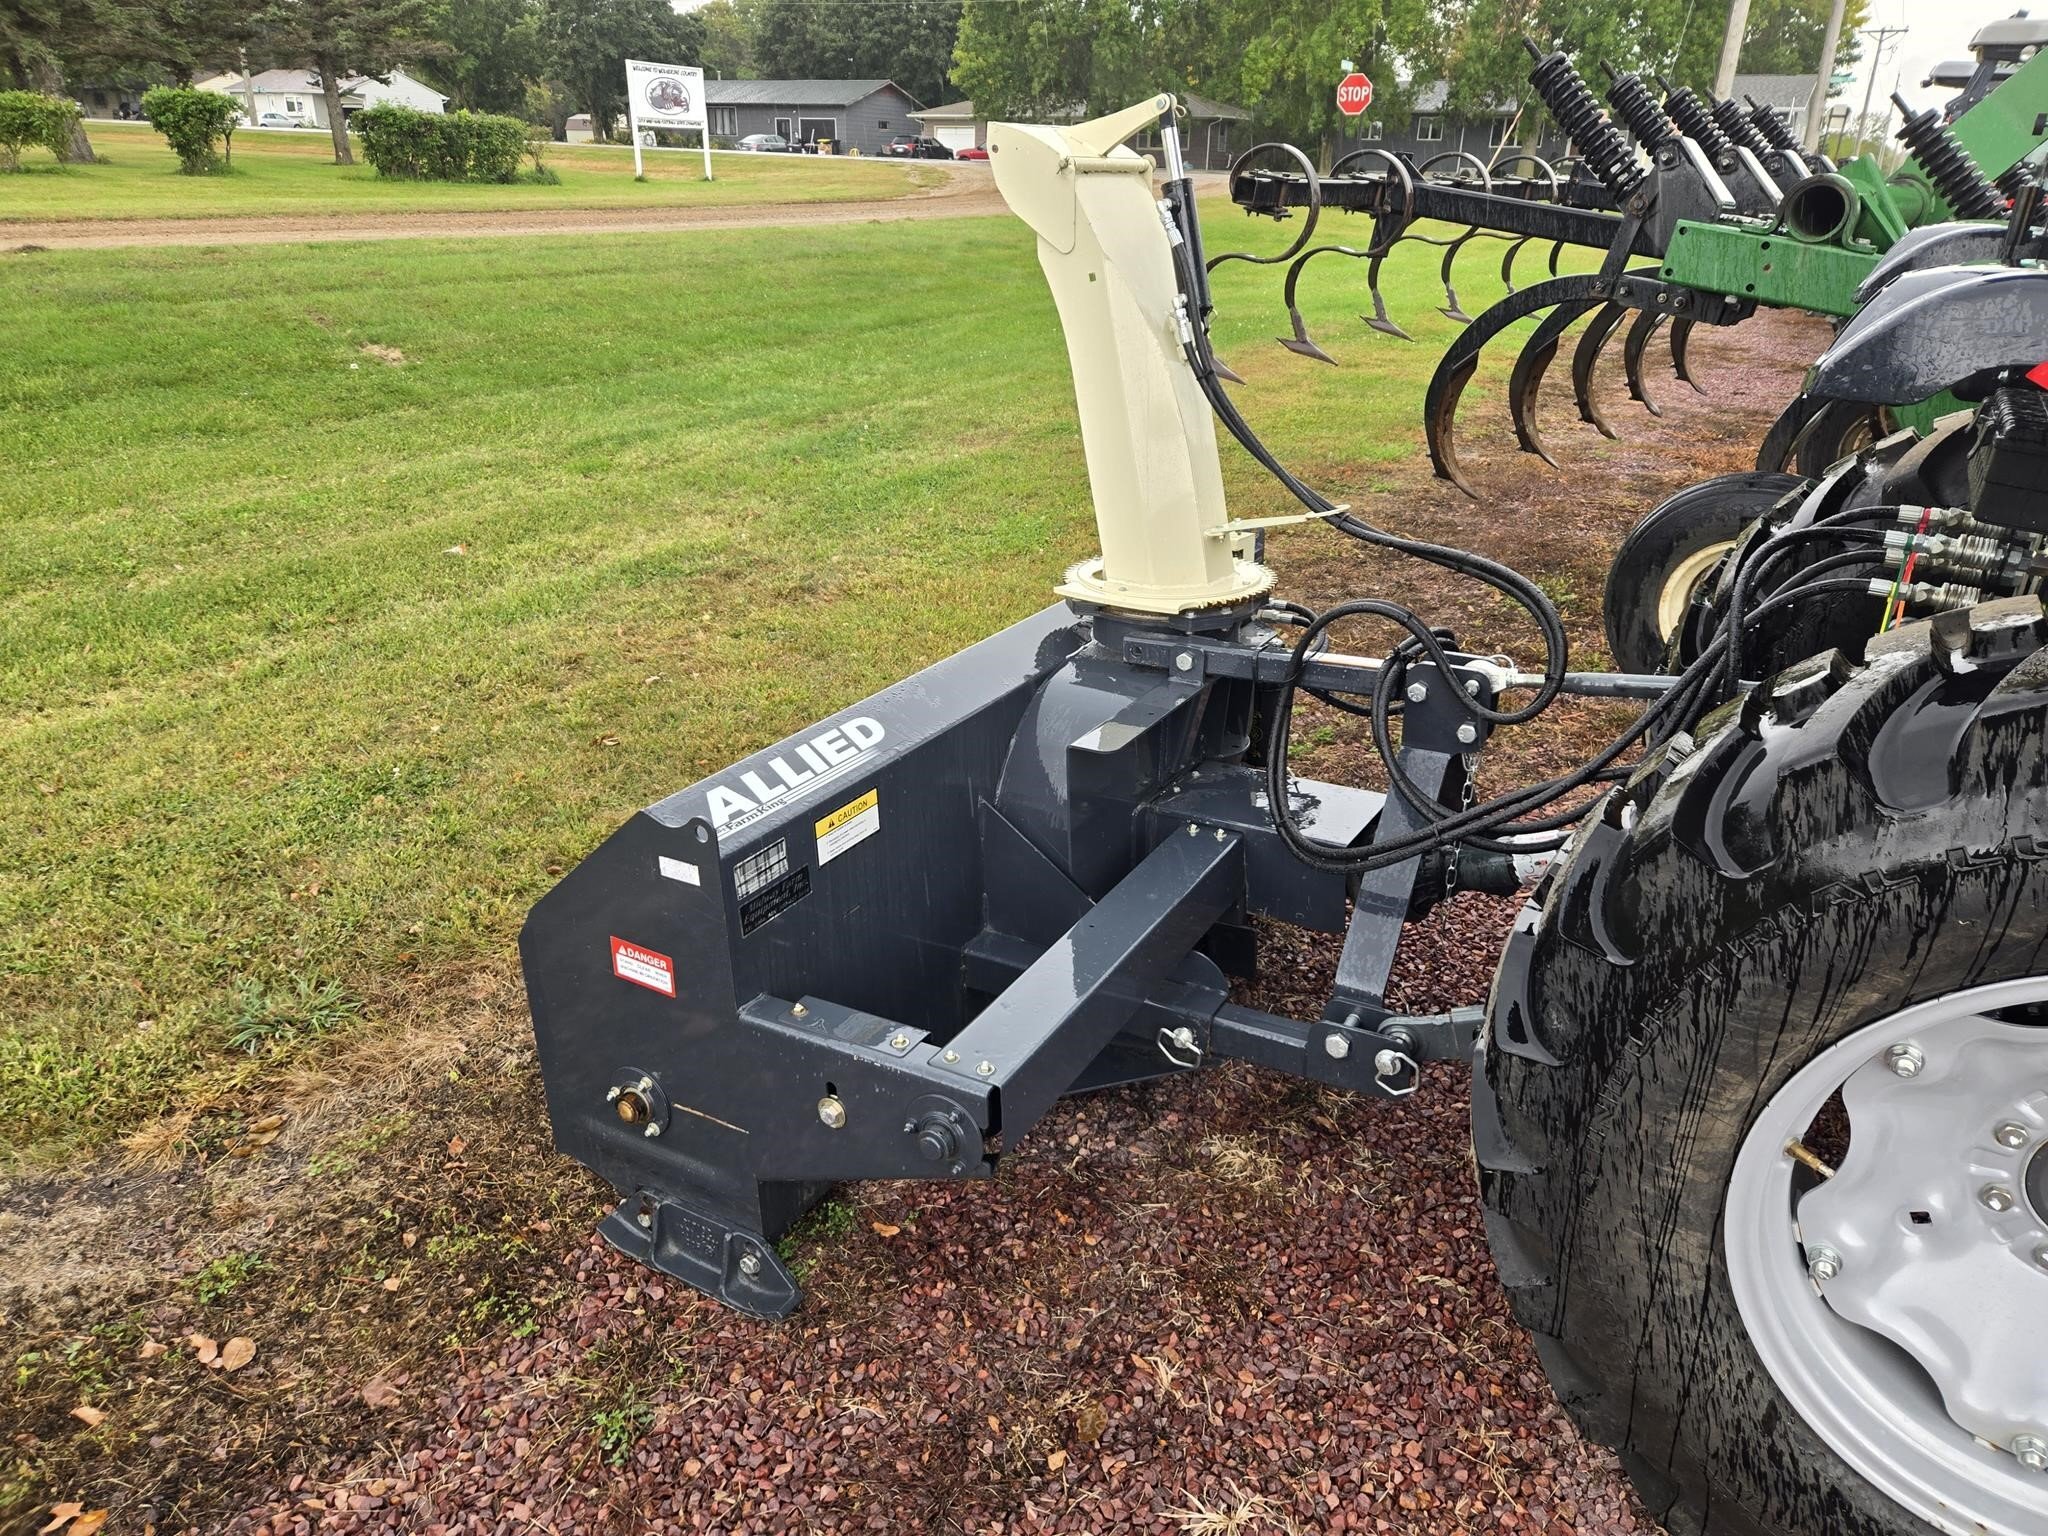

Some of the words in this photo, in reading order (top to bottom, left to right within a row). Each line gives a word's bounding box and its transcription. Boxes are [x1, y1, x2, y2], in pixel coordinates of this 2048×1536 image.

[1339, 86, 1370, 102] STOP
[706, 716, 886, 830] ALLIED
[837, 799, 868, 823] CAUTION
[627, 948, 667, 970] DANGER
